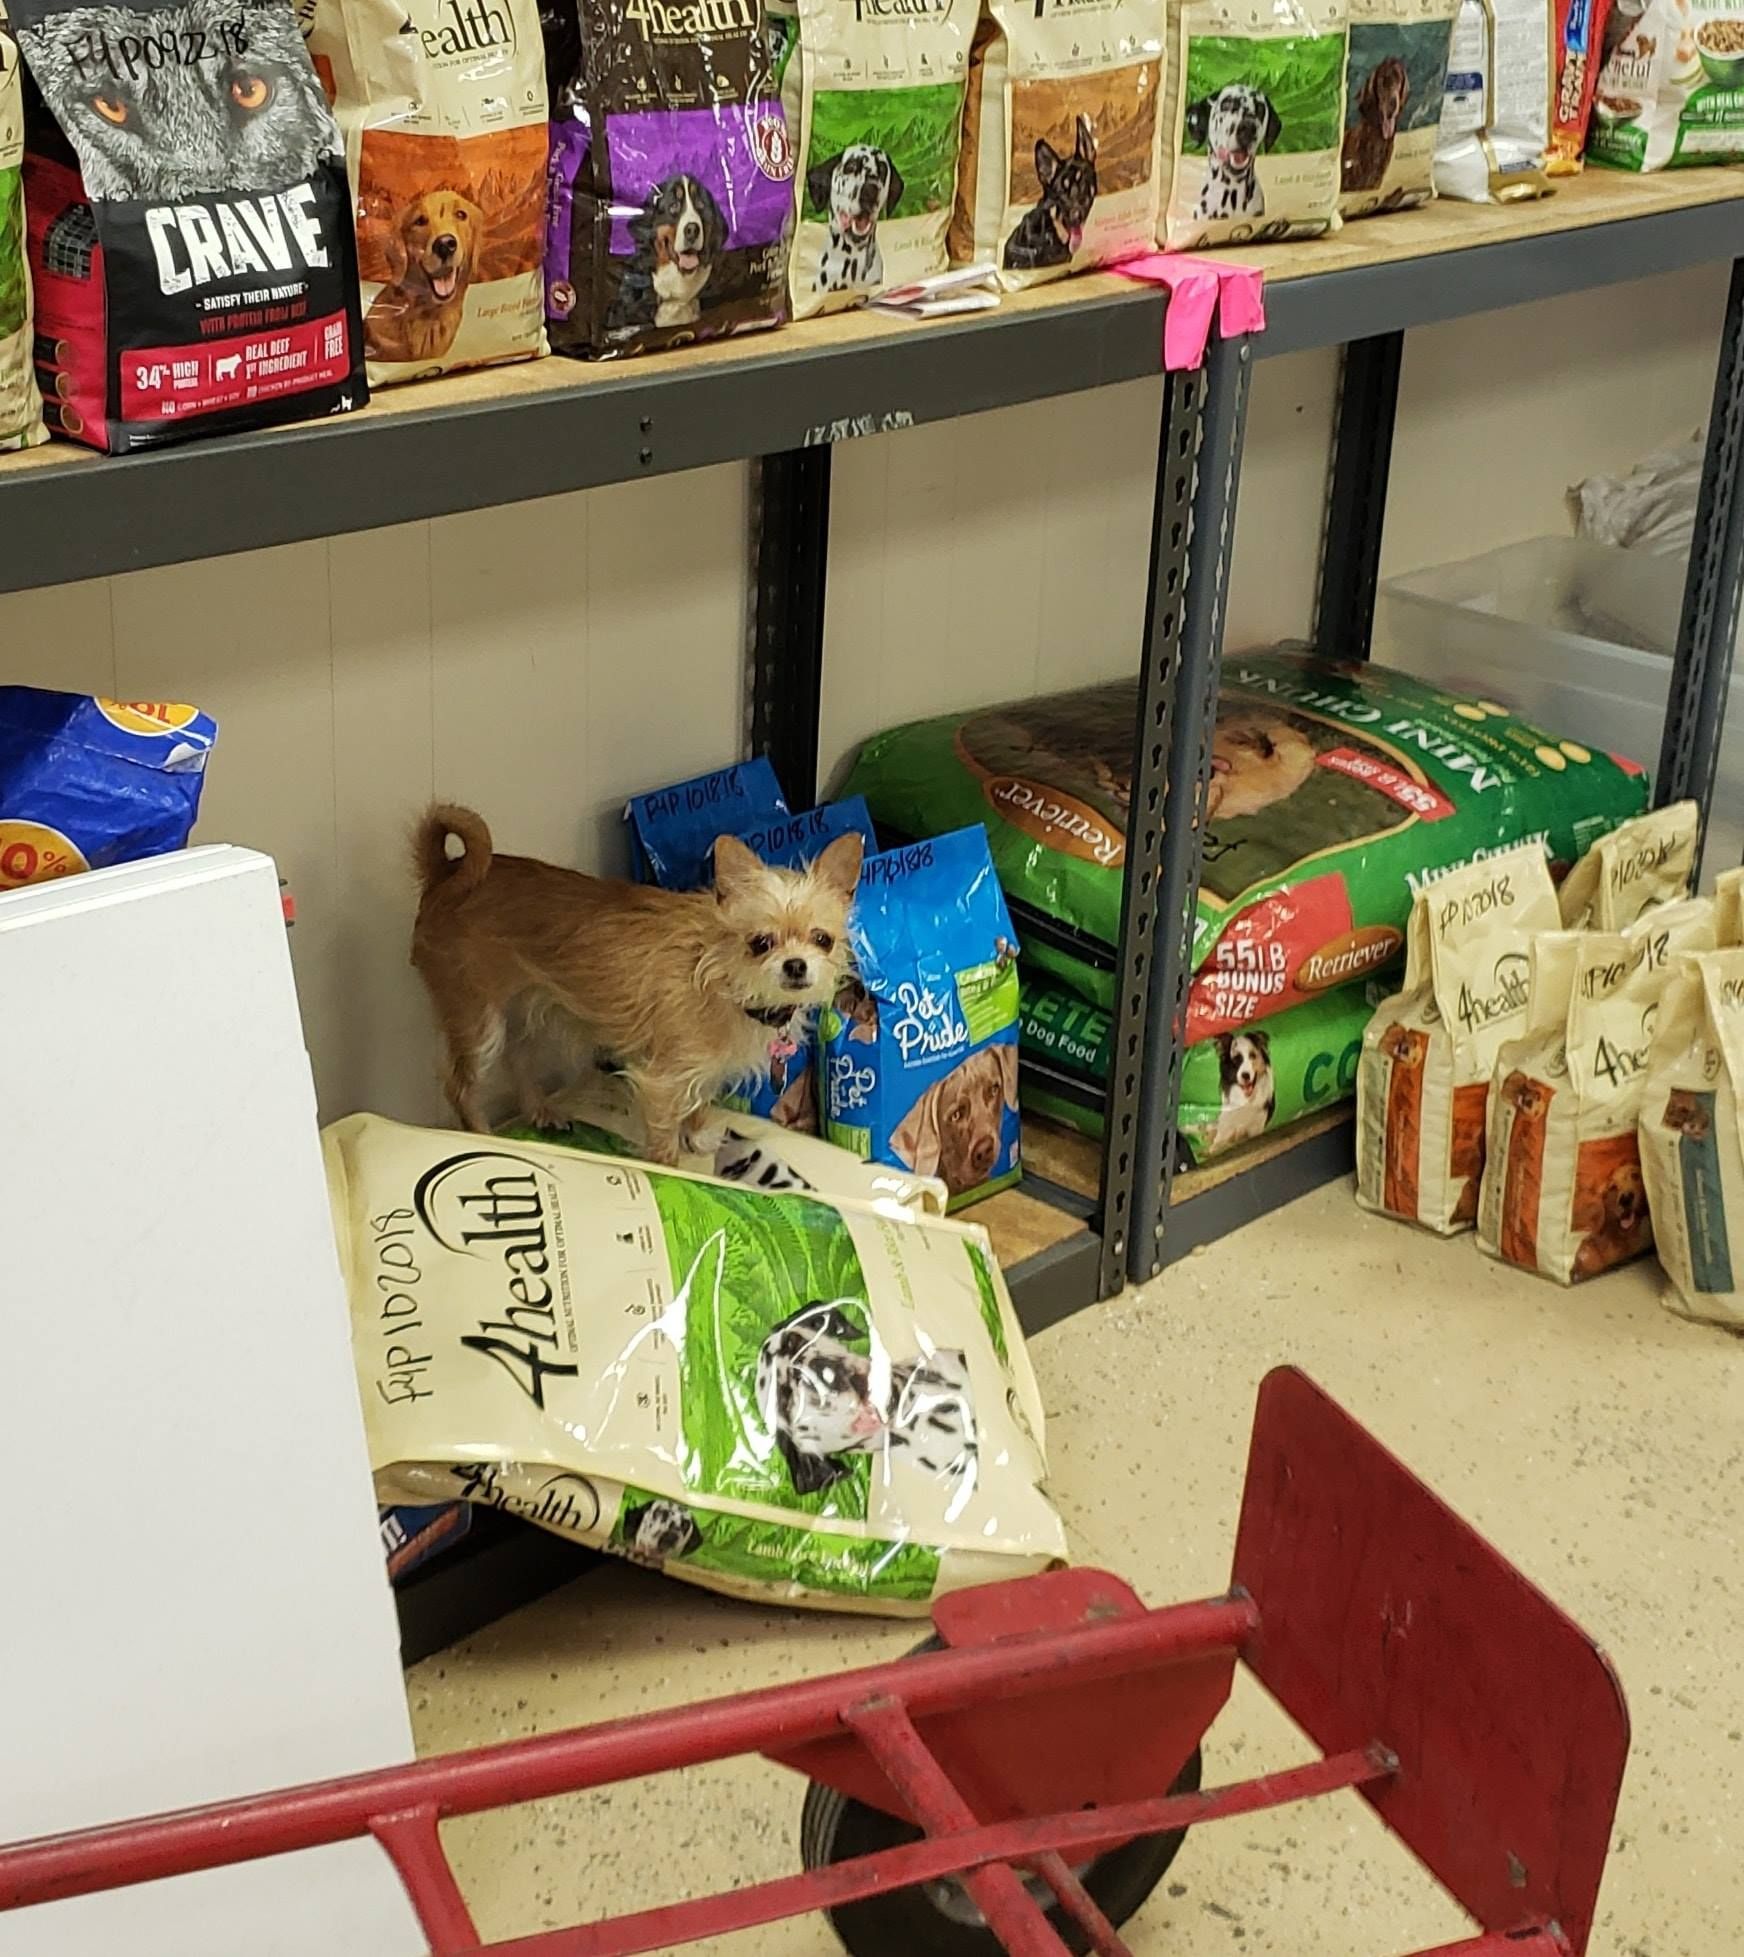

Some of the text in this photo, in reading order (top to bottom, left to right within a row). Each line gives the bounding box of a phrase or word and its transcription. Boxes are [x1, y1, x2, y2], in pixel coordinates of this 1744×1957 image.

[145, 182, 329, 296] CRAVE
[203, 284, 303, 311] SATISFY THEIR NATURE
[245, 337, 290, 361] REAL BEEF
[258, 350, 308, 377] INGREDIENT
[325, 336, 344, 360] FREE
[172, 360, 199, 379] HIGH
[1383, 719, 1502, 794] MINI
[995, 782, 1122, 865] Retriever
[1308, 937, 1395, 983] Retriever
[898, 981, 944, 1020] Pet
[1215, 969, 1286, 996] BONUS
[1215, 991, 1259, 1020] SIZE
[893, 1010, 969, 1061] Pride
[1026, 1018, 1056, 1047] Dog
[1058, 1033, 1097, 1064] Food
[848, 1066, 876, 1111] Pet
[456, 1171, 579, 1412] 4health
